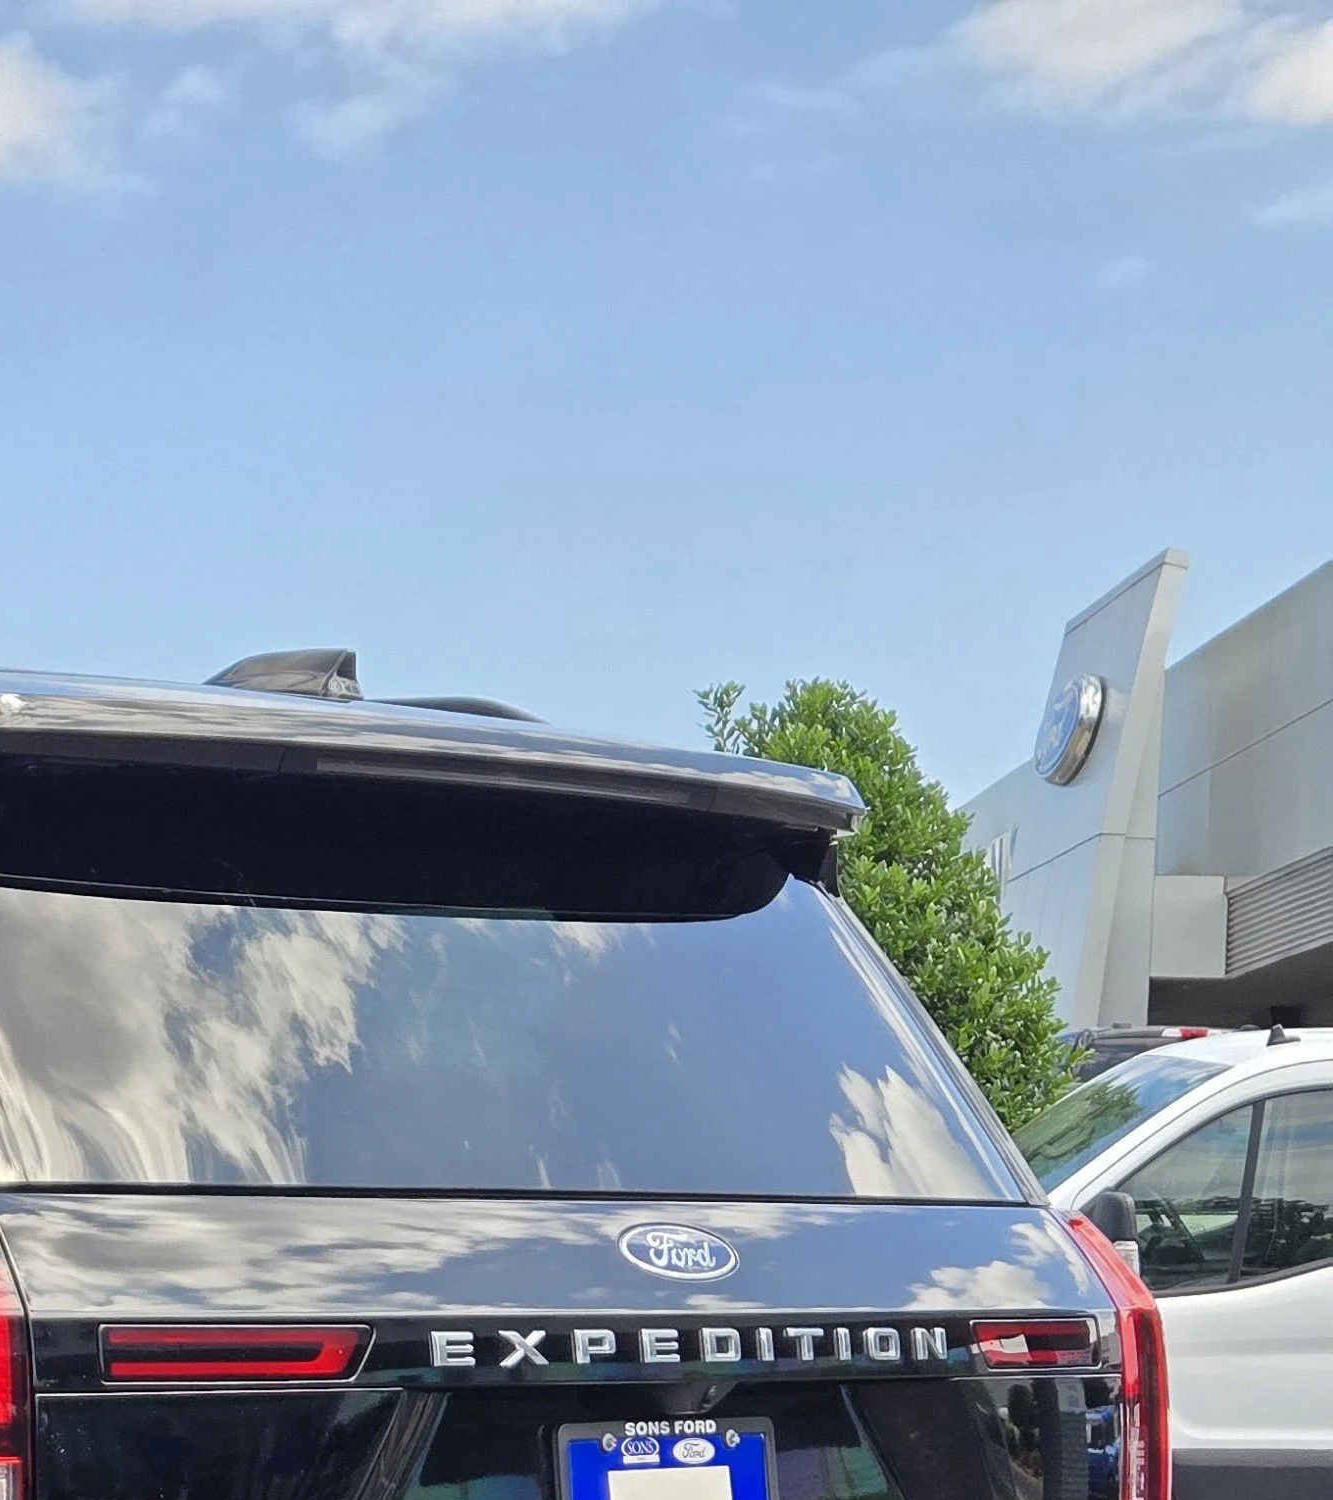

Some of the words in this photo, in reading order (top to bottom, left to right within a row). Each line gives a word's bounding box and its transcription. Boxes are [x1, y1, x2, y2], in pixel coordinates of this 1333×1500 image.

[646, 1231, 716, 1269] Ford
[430, 1327, 949, 1368] EXPEDITION
[624, 1421, 670, 1436] SONS
[674, 1419, 717, 1435] FORD
[682, 1442, 707, 1459] Ford
